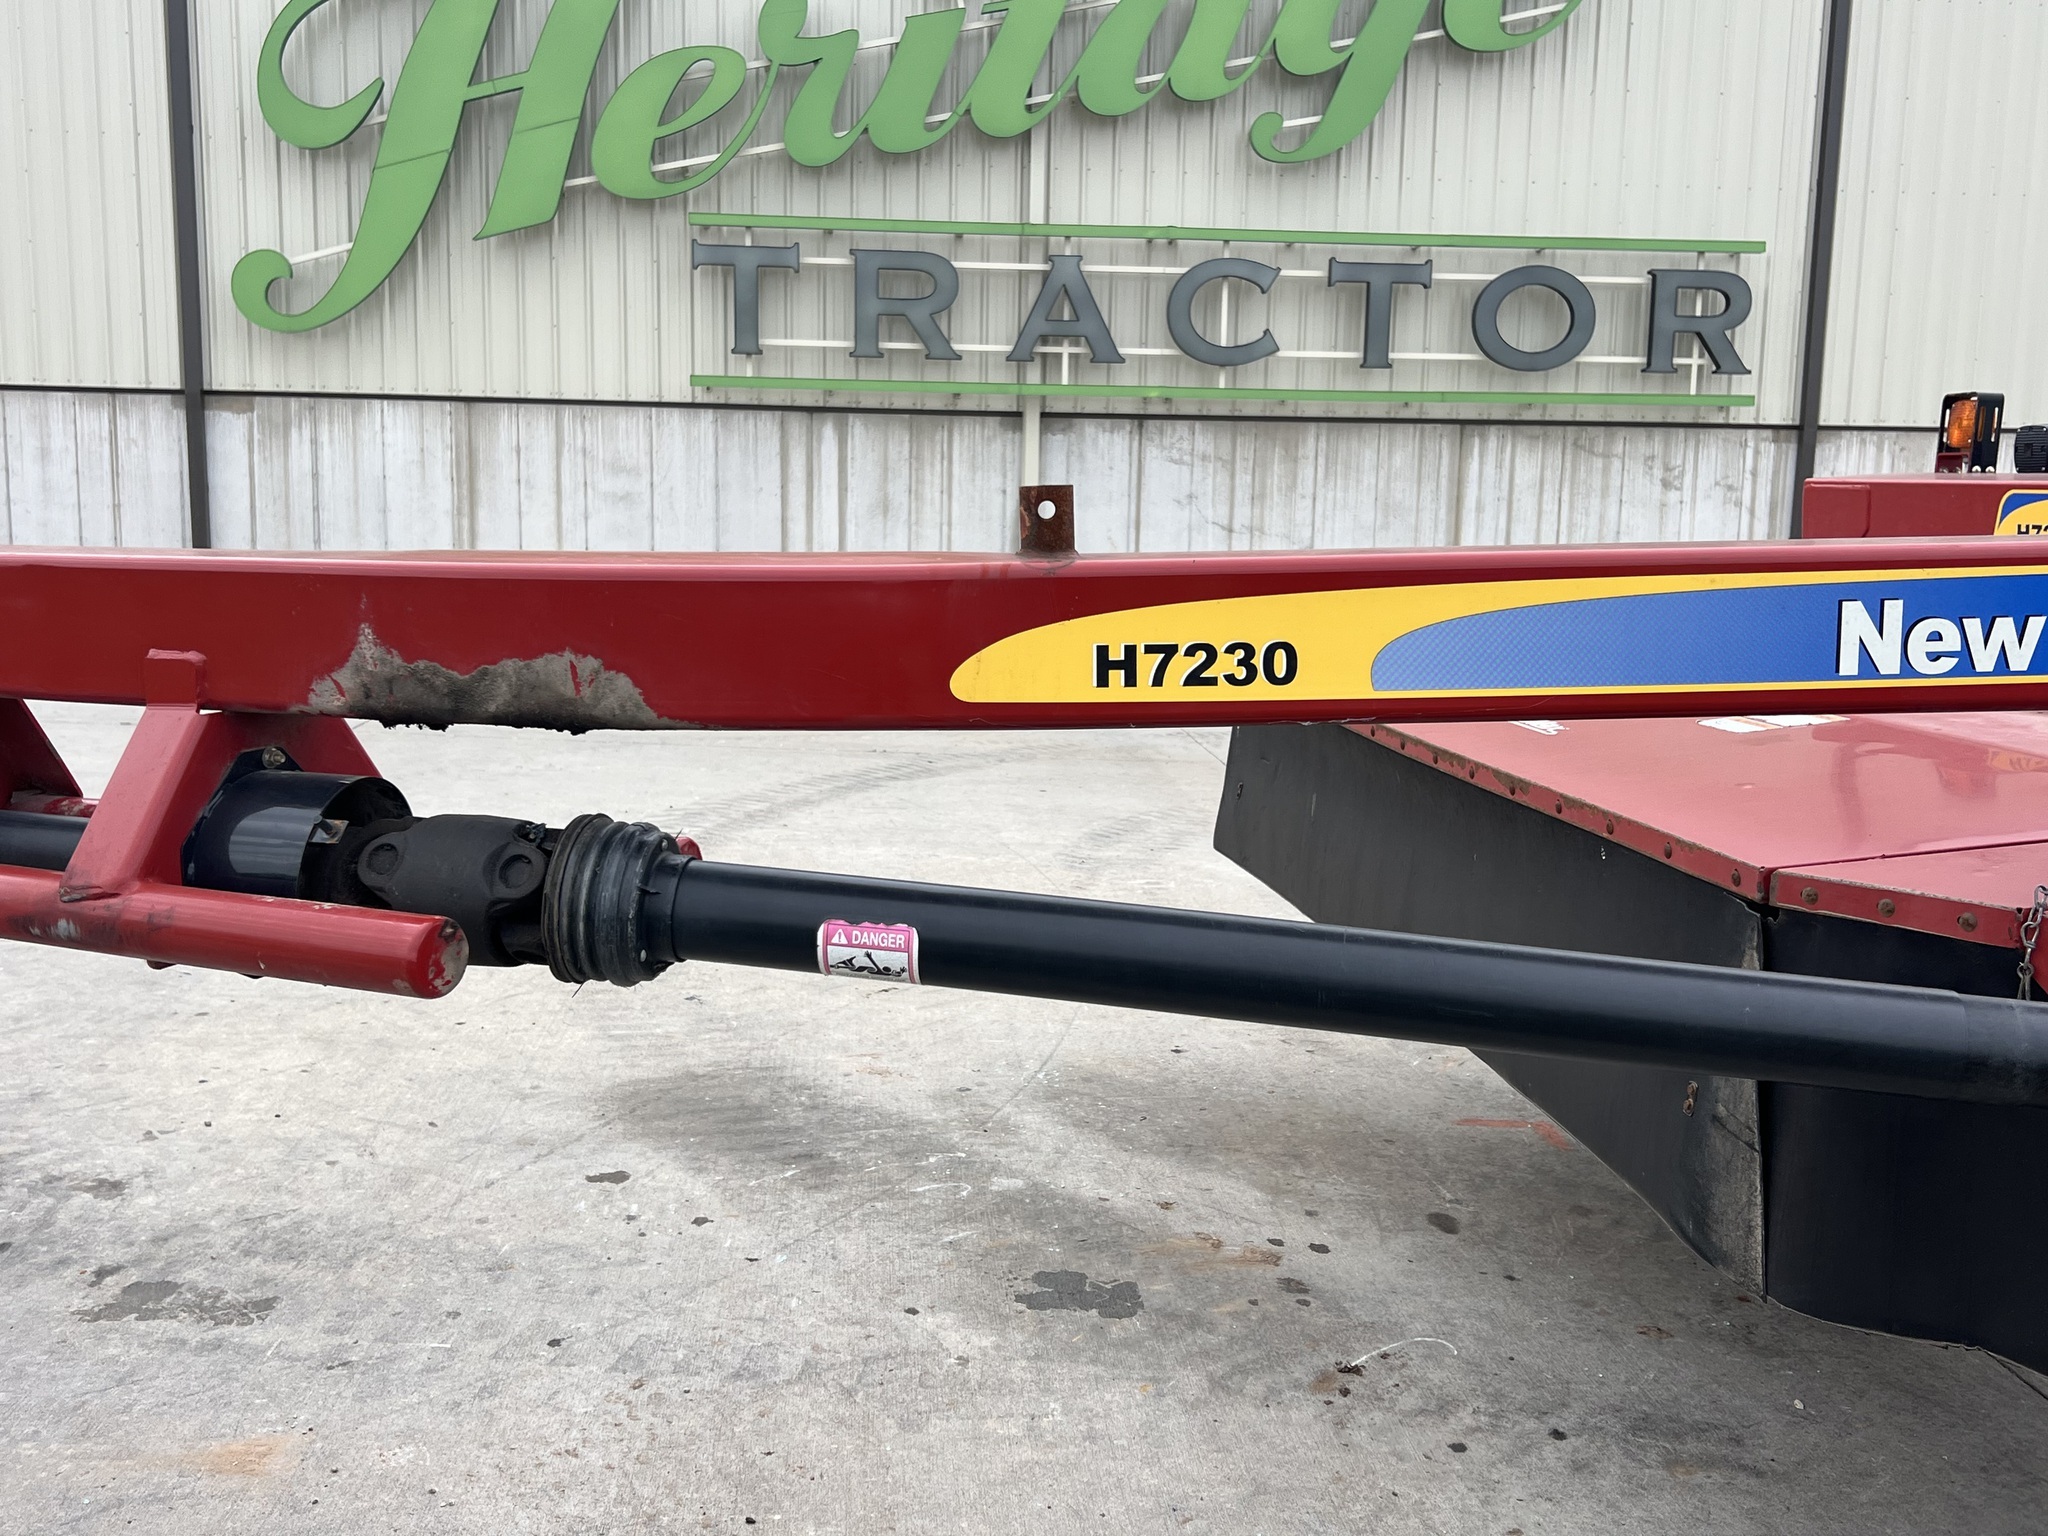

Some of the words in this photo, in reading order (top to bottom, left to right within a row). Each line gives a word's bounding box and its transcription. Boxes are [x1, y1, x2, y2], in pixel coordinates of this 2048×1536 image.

[691, 242, 1752, 375] TRACTOR
[2016, 523, 2048, 535] H7
[1836, 598, 2048, 677] New
[1094, 641, 1298, 688] H7230
[851, 930, 905, 948] DANGER
